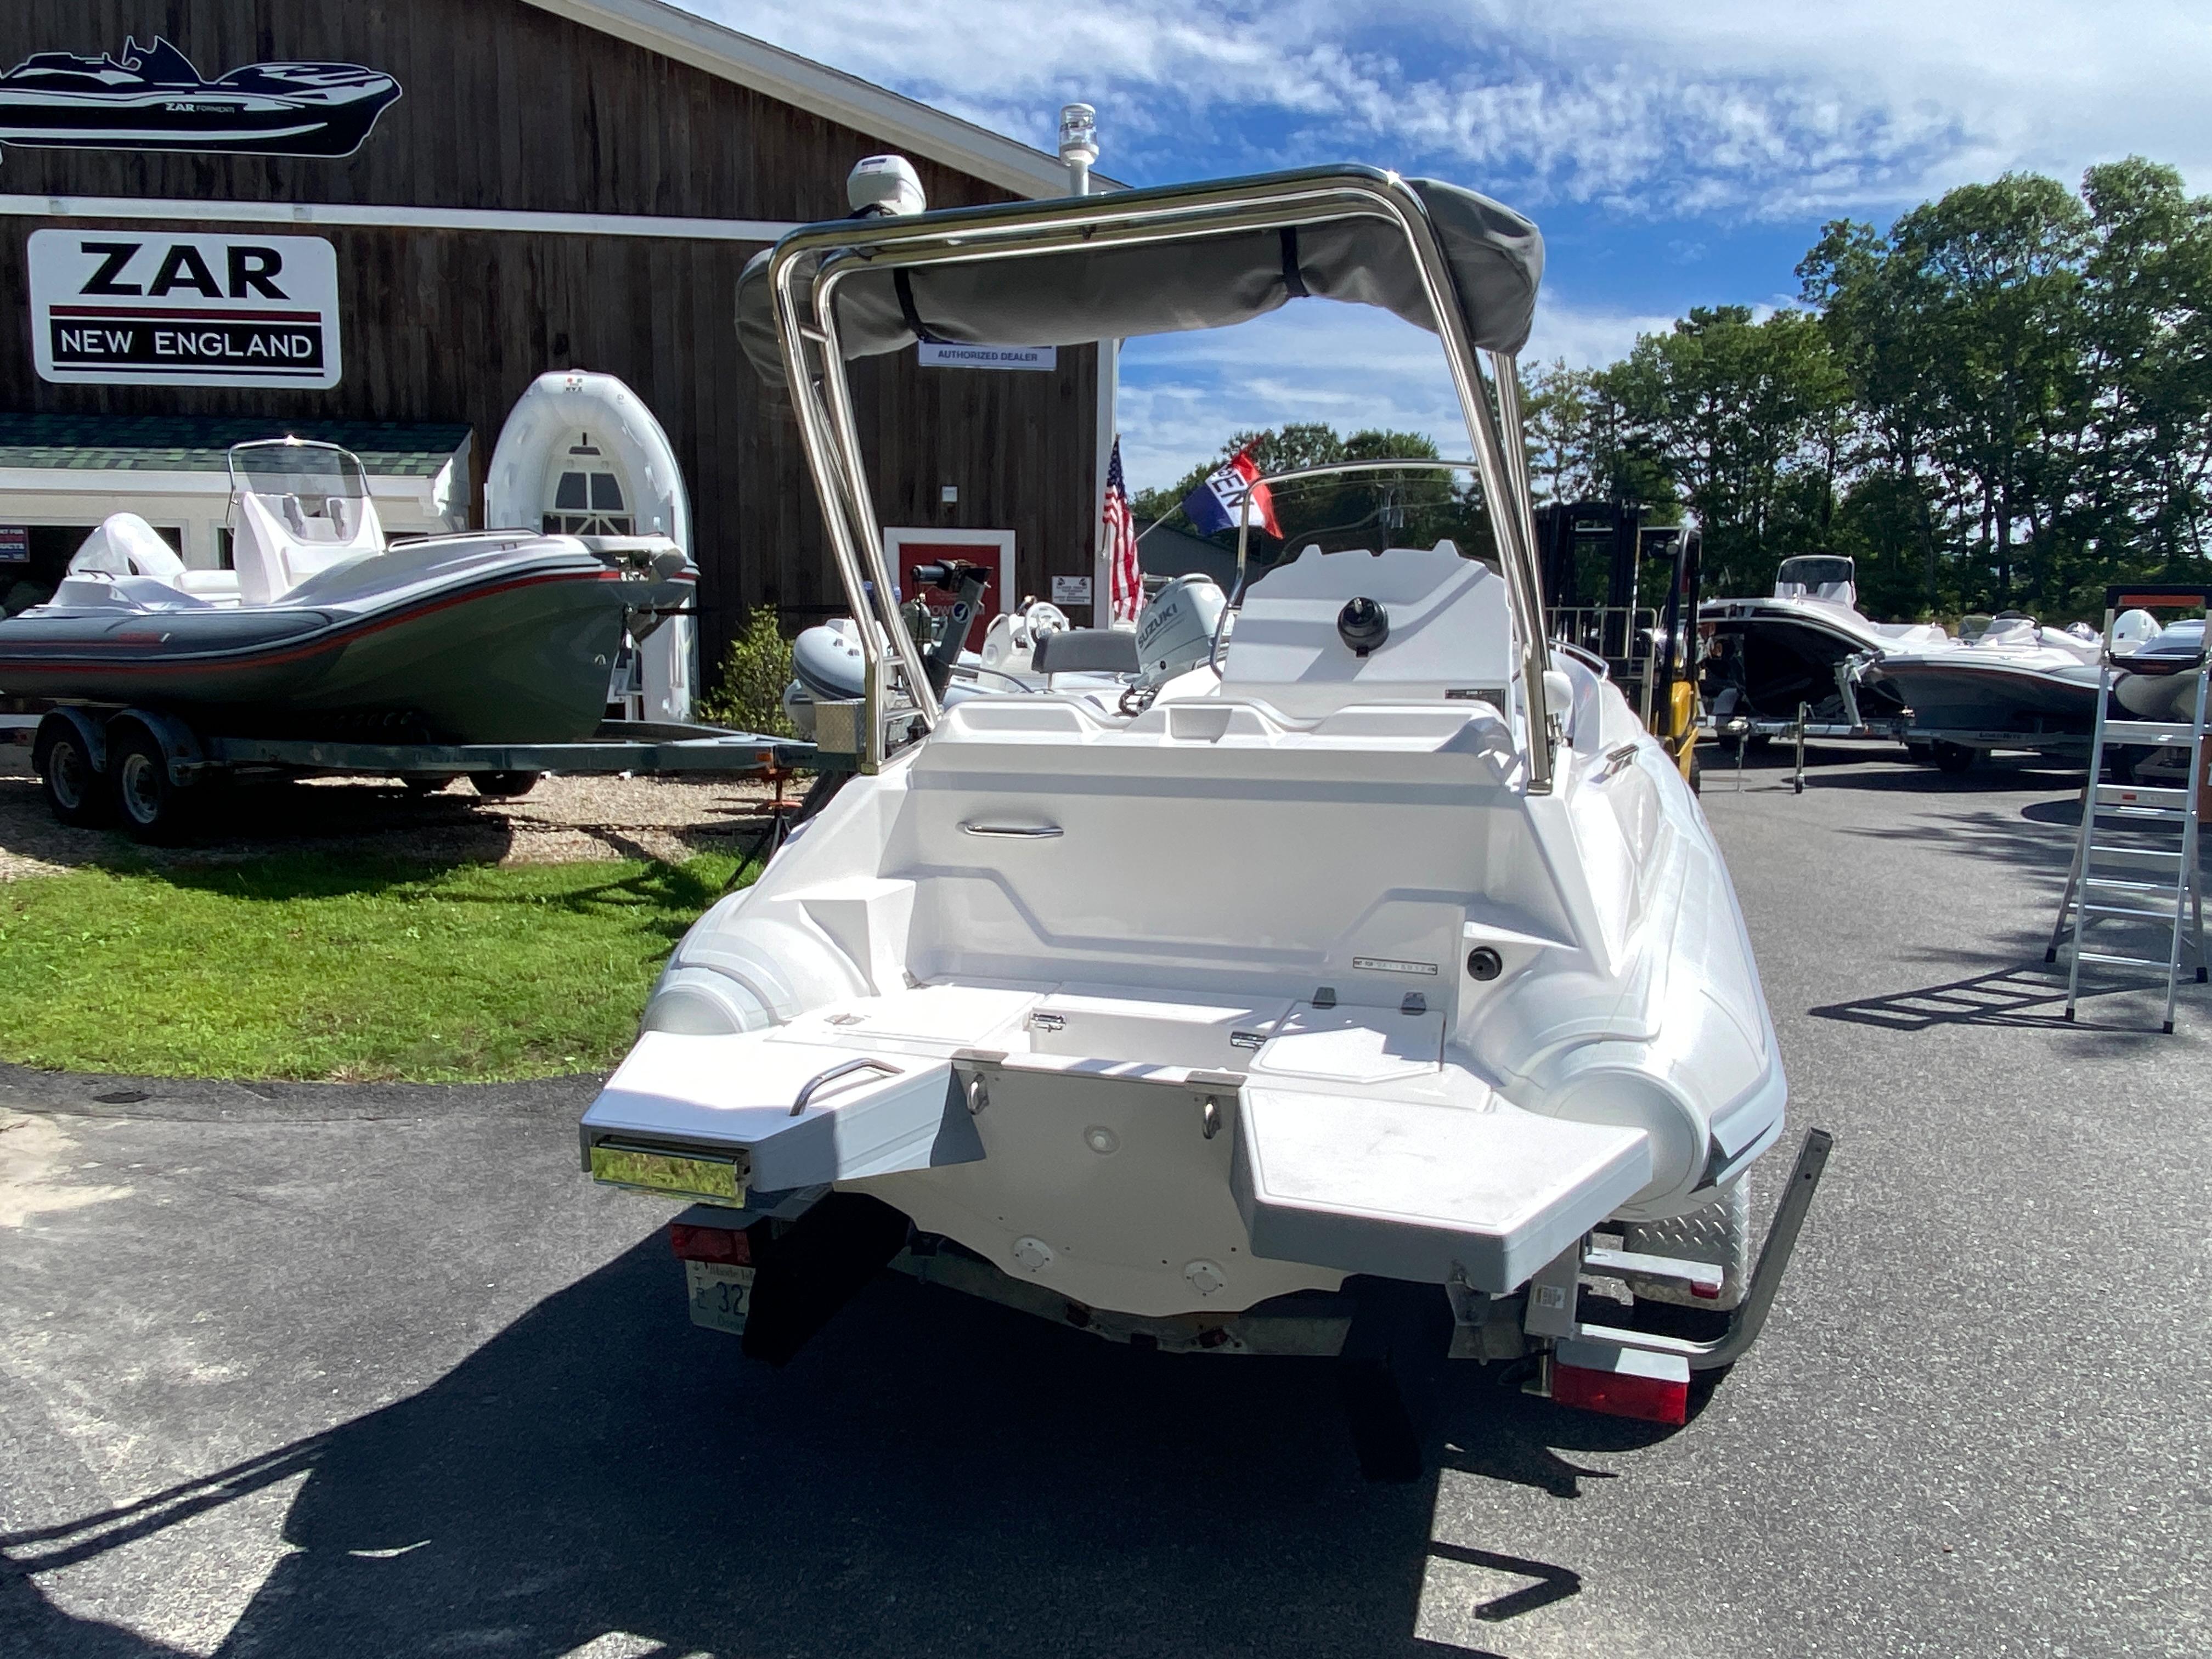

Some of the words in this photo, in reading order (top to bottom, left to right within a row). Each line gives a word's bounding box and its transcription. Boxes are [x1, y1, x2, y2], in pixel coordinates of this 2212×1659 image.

[165, 103, 195, 112] ZAR
[79, 241, 291, 300] ZAR
[61, 329, 133, 353] NEW
[155, 332, 312, 358] ENGLAND
[938, 350, 998, 360] AUTHORIZED
[1001, 352, 1038, 362] DEALER
[1138, 602, 1178, 650] SUZUKI
